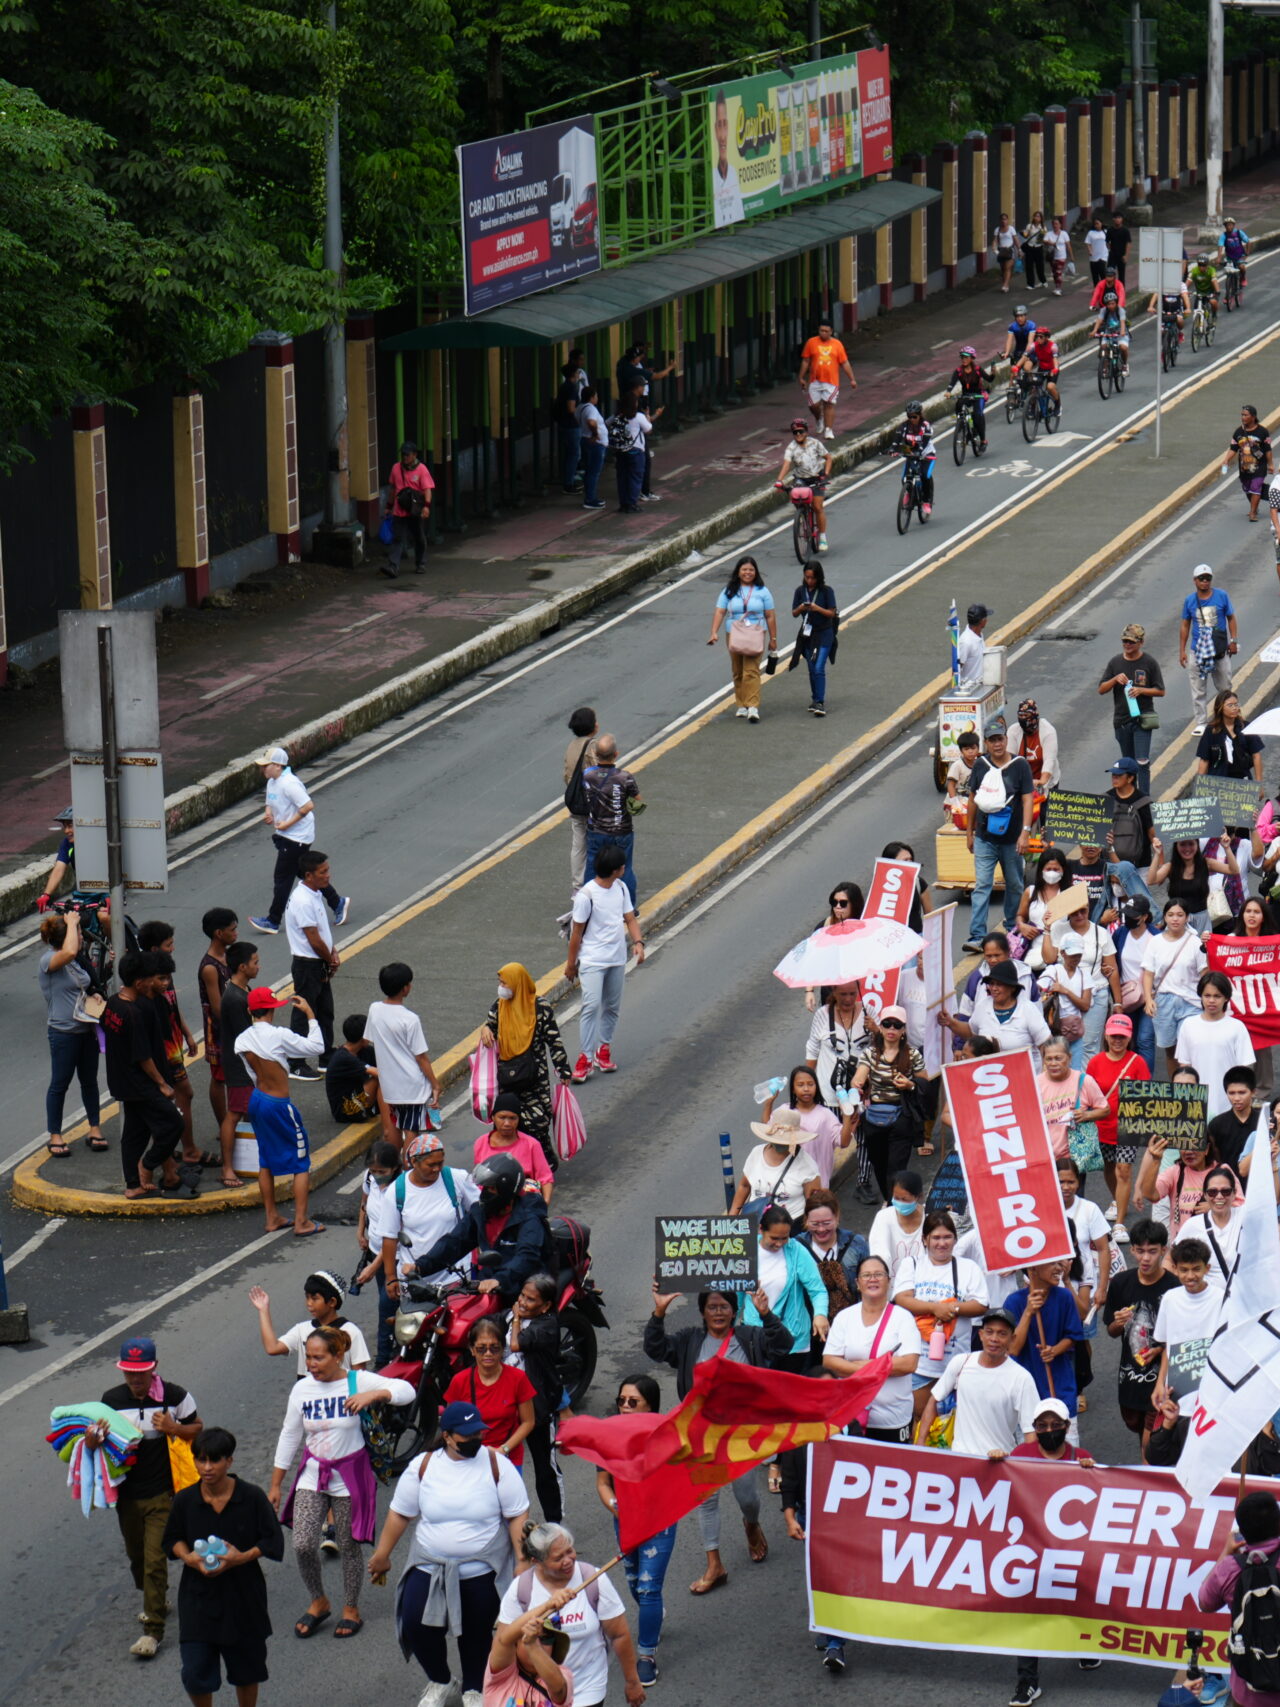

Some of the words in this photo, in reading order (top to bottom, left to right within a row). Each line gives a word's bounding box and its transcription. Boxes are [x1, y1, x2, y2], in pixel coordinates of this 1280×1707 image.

[738, 158, 777, 184] FOODSERVICE
[469, 200, 482, 218] CAR
[482, 195, 496, 212] AND
[495, 189, 516, 208] TRUCK
[516, 180, 548, 204] FINANCING
[496, 235, 511, 252] APPLY
[511, 231, 525, 248] NOW!
[1053, 829, 1075, 839] NOW
[1077, 832, 1096, 842] NA!
[1225, 955, 1244, 967] AND
[1247, 950, 1275, 966] ALLIED
[1119, 1080, 1172, 1099] DESERVE
[1144, 1100, 1183, 1119] SAHOD
[1187, 1101, 1204, 1119] NA
[971, 1062, 1048, 1260] SENTRO
[660, 1219, 708, 1238] WAGE
[710, 1218, 751, 1237] HIKE
[664, 1237, 747, 1258] ISABATAS,
[659, 1260, 684, 1277] 150
[686, 1259, 750, 1276] PATAAS!
[823, 1459, 1025, 1546] PBBM,
[881, 1528, 1086, 1601] WAGE
[1095, 1552, 1231, 1615] HIK
